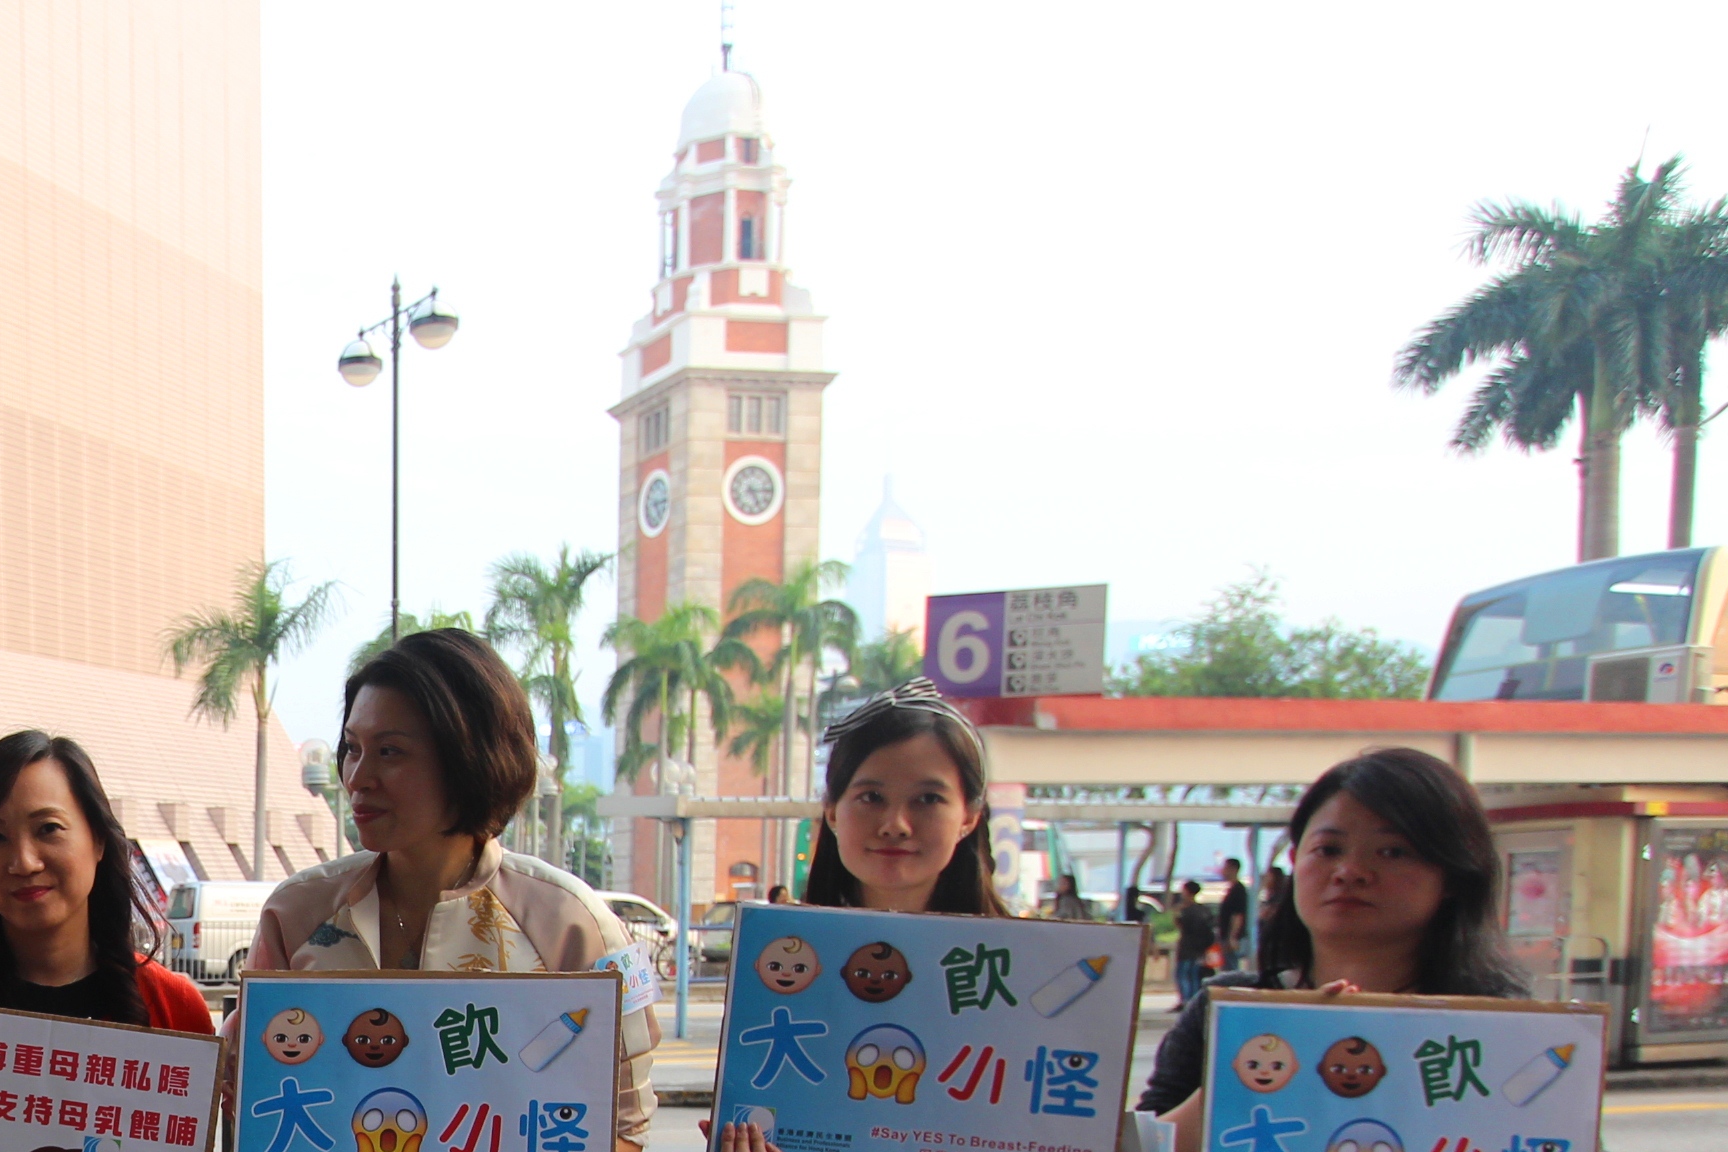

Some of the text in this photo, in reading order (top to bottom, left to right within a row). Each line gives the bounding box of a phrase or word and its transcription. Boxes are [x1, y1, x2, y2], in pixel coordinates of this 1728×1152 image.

[937, 610, 991, 685] 6
[988, 813, 1021, 888] 6
[939, 942, 1018, 1015] 飲
[432, 1002, 509, 1076] 飲
[739, 1006, 829, 1091] 大
[1413, 1034, 1491, 1107] 飲
[871, 1127, 908, 1143] #Say
[913, 1131, 943, 1144] YES
[948, 1134, 966, 1146] To
